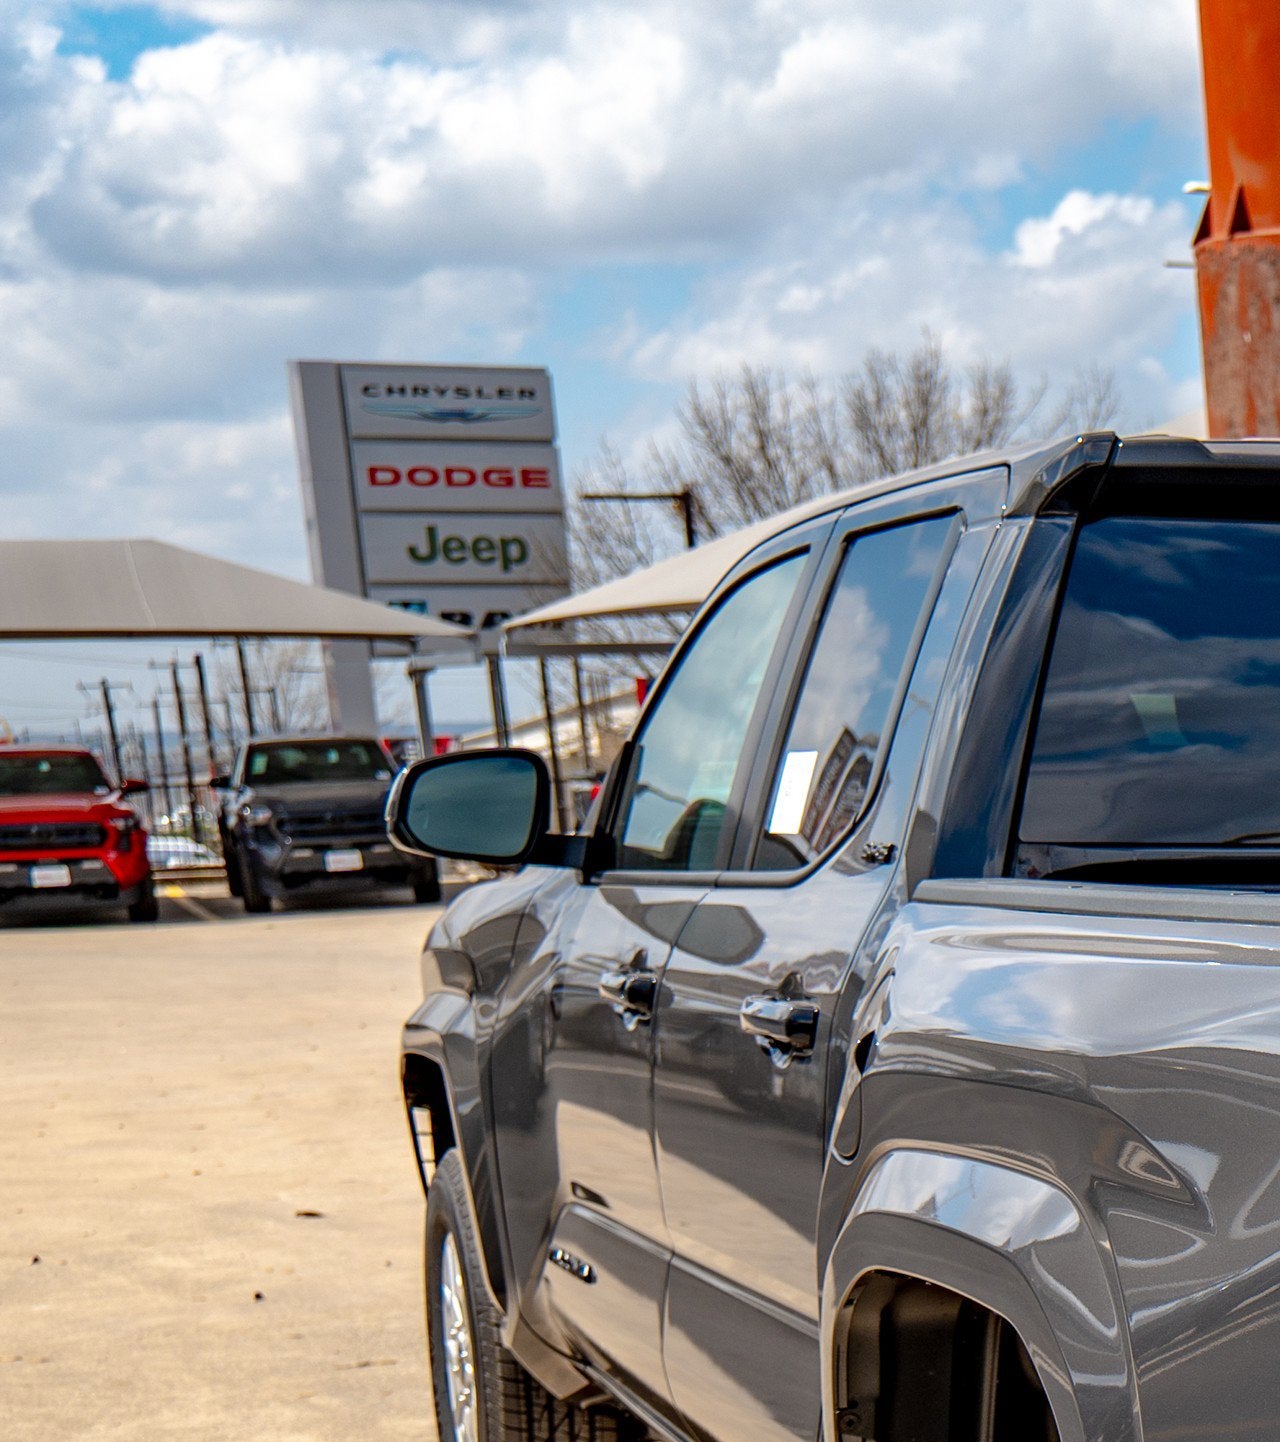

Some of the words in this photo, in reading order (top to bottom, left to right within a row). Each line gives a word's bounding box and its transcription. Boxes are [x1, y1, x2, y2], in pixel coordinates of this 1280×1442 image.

[362, 383, 537, 400] CHRYSLER
[367, 466, 550, 488] DODGE
[407, 525, 529, 572] Jeep
